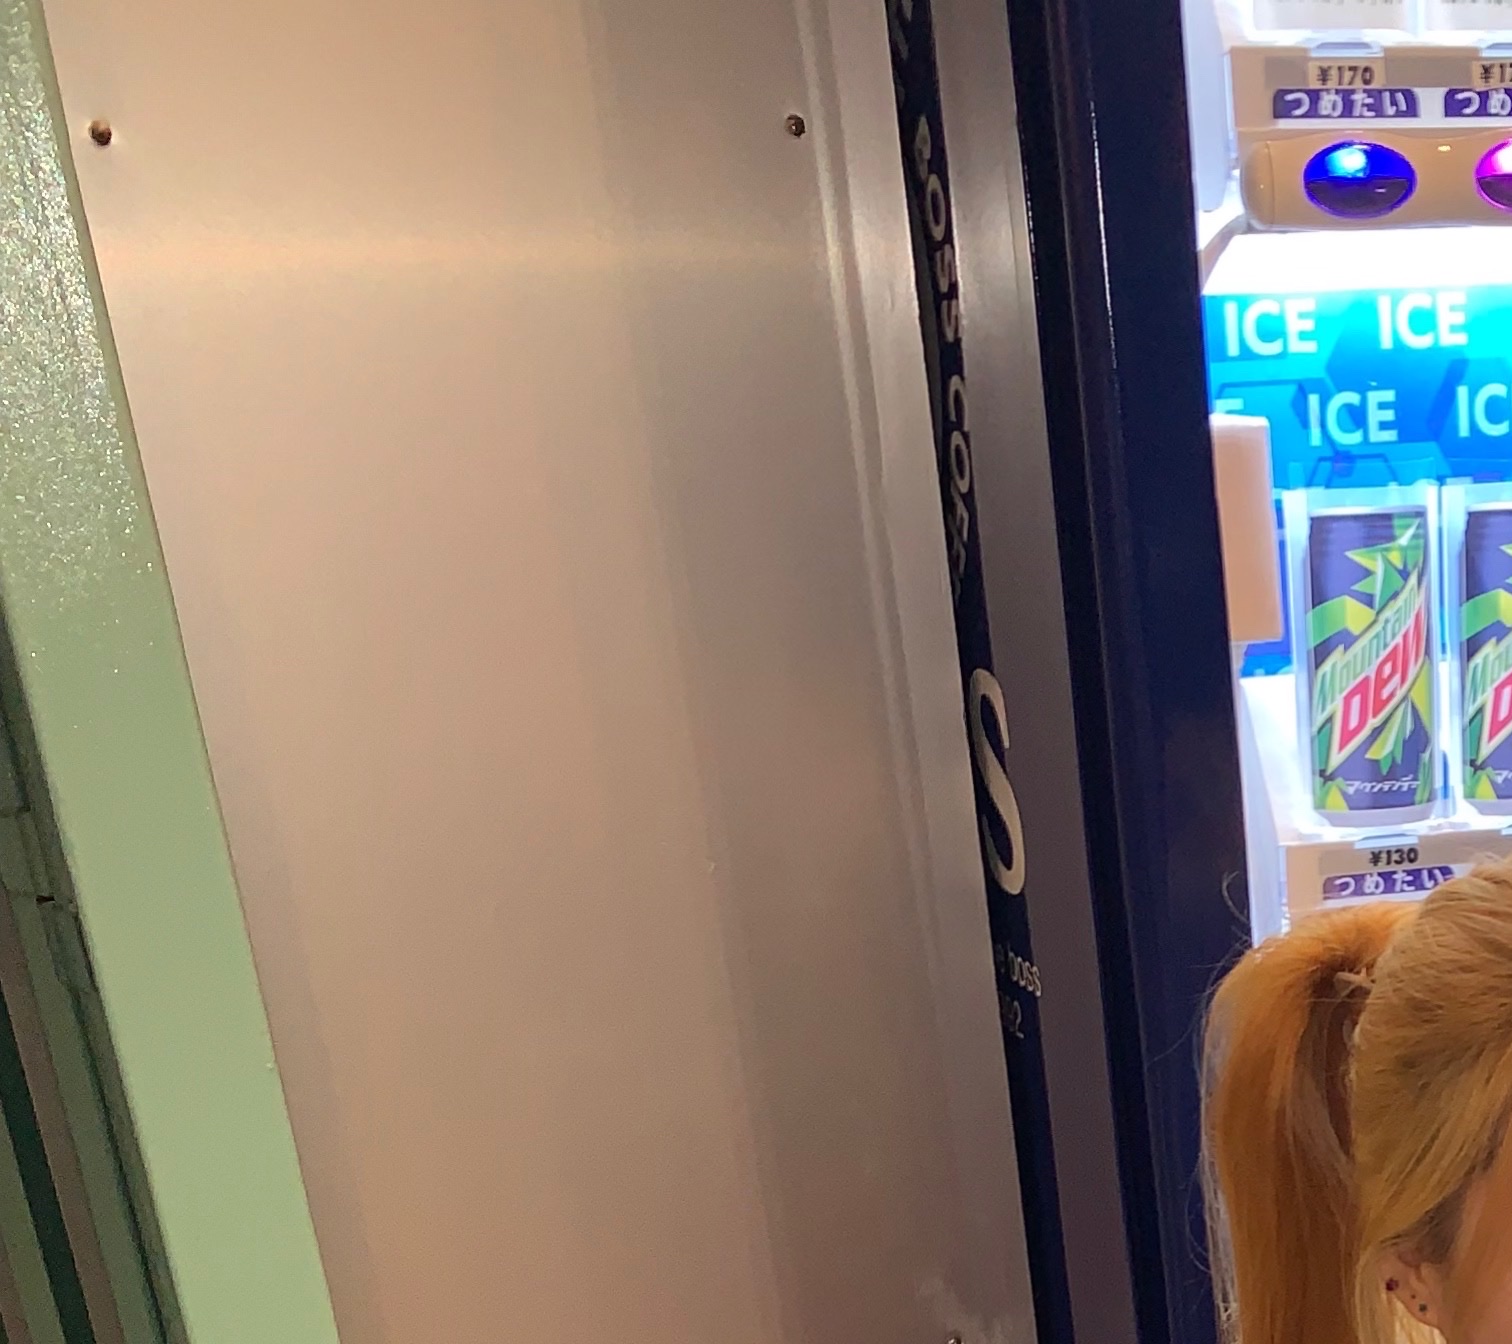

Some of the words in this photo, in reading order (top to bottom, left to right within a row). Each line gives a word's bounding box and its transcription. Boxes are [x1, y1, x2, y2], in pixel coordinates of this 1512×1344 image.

[1317, 65, 1374, 87] ¥170
[1282, 90, 1406, 118] つめたい
[1224, 299, 1318, 357] ICE
[1378, 291, 1468, 350] ICE
[1308, 389, 1398, 447] ICE
[1369, 847, 1419, 867] ¥130
